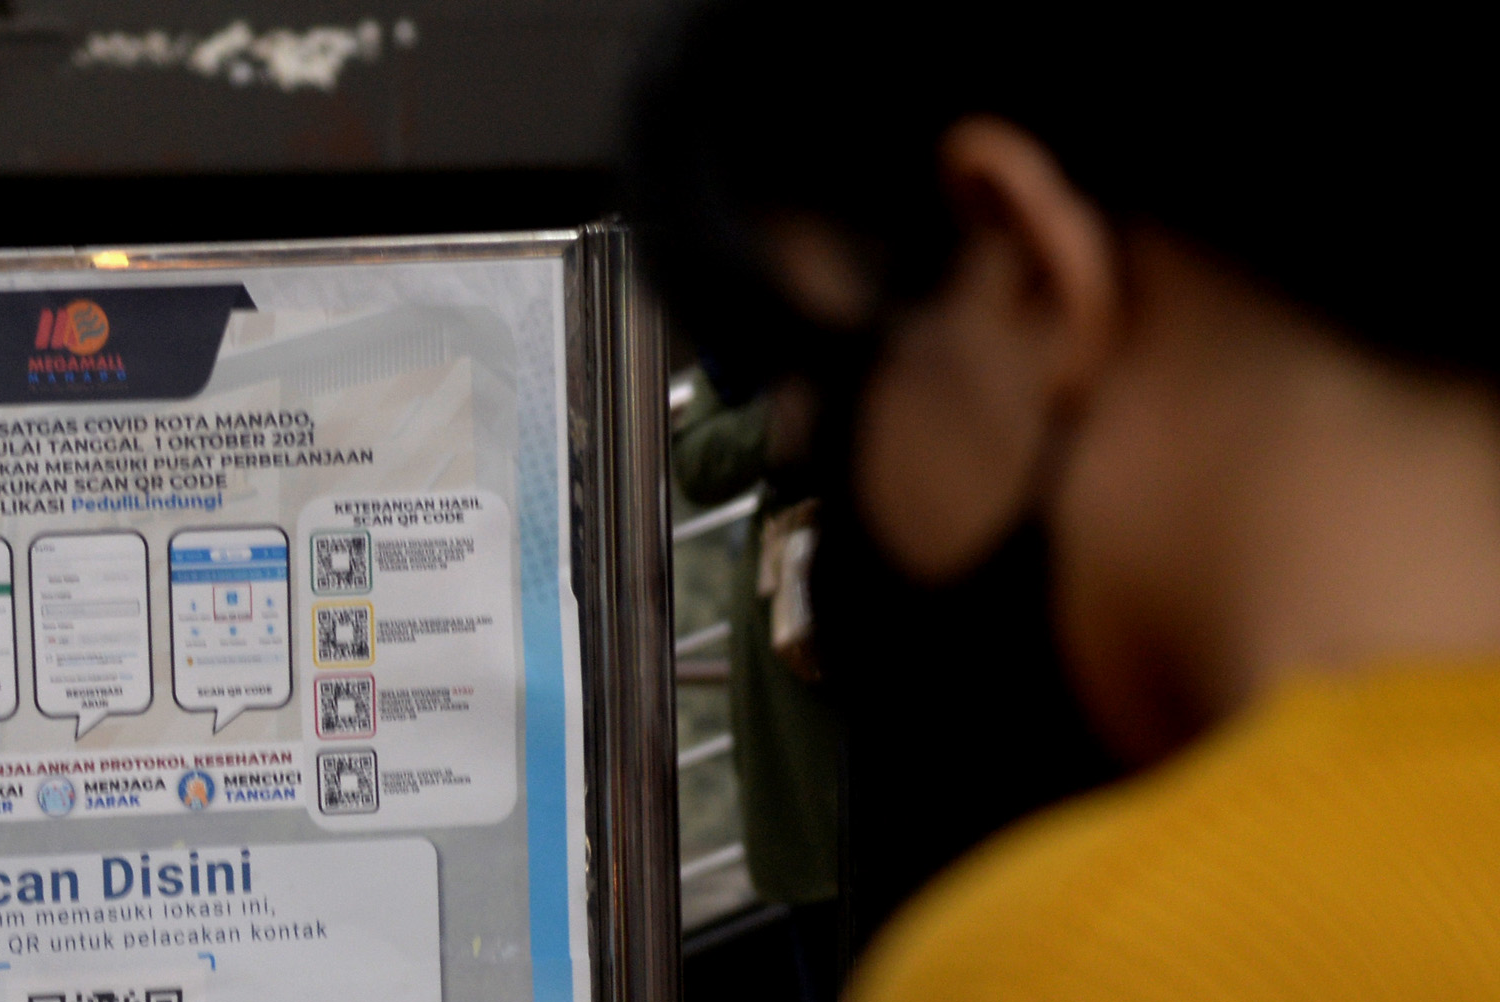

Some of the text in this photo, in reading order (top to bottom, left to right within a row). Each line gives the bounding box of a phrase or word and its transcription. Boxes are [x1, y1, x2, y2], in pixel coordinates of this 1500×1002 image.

[27, 353, 125, 372] MEGAMALL
[84, 416, 148, 435] COVID
[155, 414, 210, 432] KOTA
[215, 411, 314, 431] MANADO,
[49, 436, 144, 455] TANGGAL
[155, 434, 162, 451] 1
[168, 431, 265, 451] OKTOBER
[271, 430, 315, 448] 2021
[45, 456, 147, 474] MEMASUKI
[153, 453, 213, 471] PUSAT
[220, 448, 373, 469] PERBELANJAAN
[74, 476, 128, 494] SCAN
[134, 474, 164, 497] QR
[169, 472, 227, 491] CODE
[71, 492, 223, 513] PeduliLindungi
[334, 496, 482, 515] KETERANGAN HASIL
[353, 511, 465, 527] SCAN QR CODE
[100, 755, 186, 773] PROTOKOL
[194, 751, 293, 768] KESEHATAN
[84, 777, 166, 795] MENJAGA
[223, 771, 302, 788] MENCUCI
[86, 794, 141, 810] JARAK
[225, 787, 296, 803] TANGAN
[102, 848, 252, 900] Disini
[36, 903, 153, 927] memasuki
[163, 901, 232, 920] lokasi
[242, 896, 276, 917] ini,
[8, 932, 40, 955] QR
[50, 929, 115, 953] untuk
[123, 924, 241, 950] pelacakan
[250, 919, 328, 942] kontak
